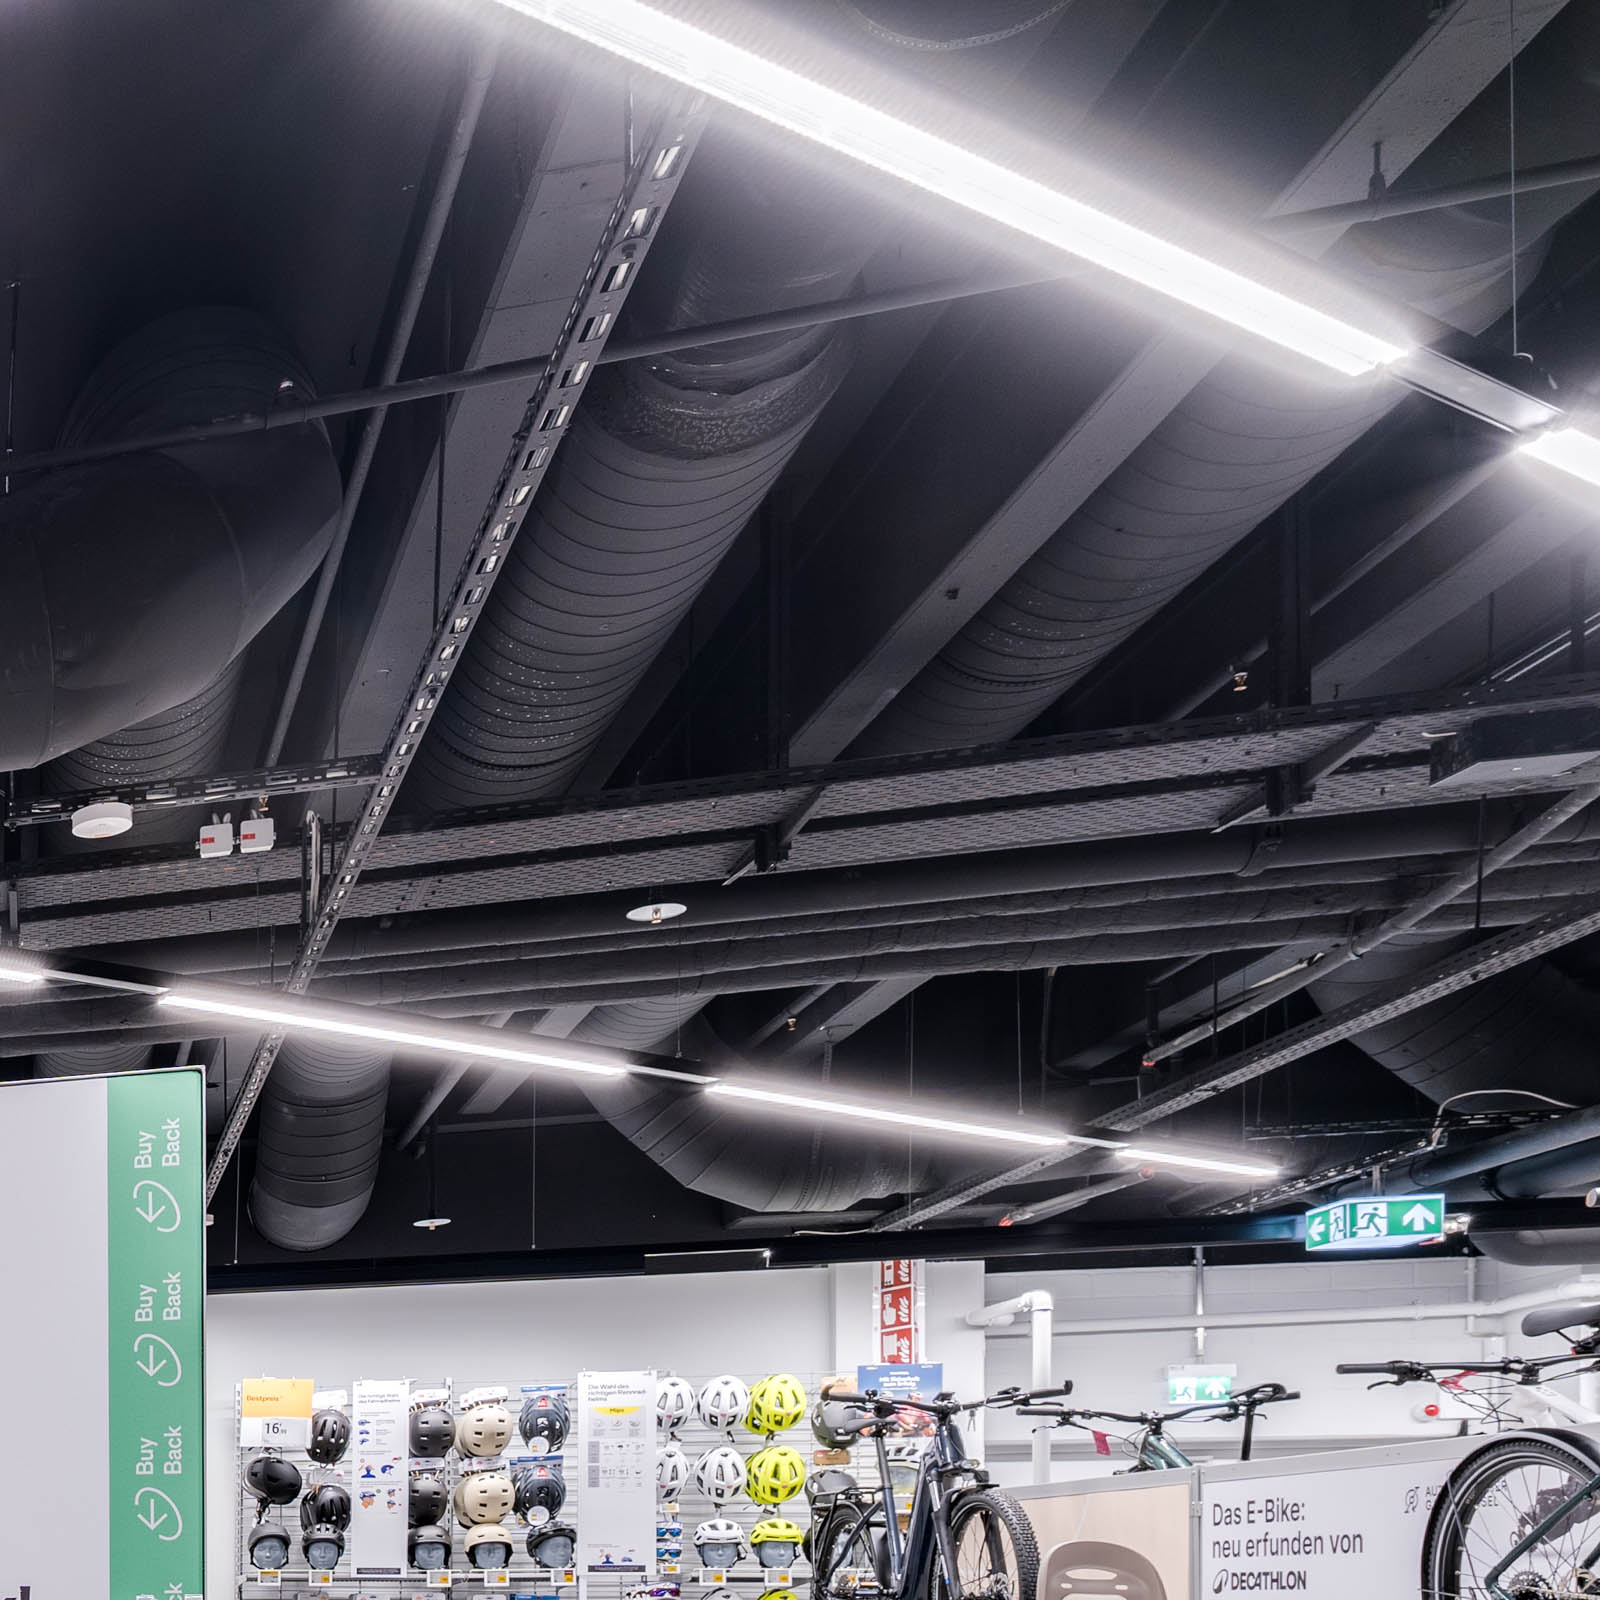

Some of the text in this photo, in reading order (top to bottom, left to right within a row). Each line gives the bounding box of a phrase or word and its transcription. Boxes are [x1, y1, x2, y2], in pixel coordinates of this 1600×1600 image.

[133, 1130, 156, 1169] Buy
[161, 1117, 181, 1167] Back
[134, 1284, 157, 1323] Buy
[162, 1271, 182, 1321] Back
[265, 1423, 280, 1434] 16
[135, 1437, 158, 1476] Buy
[163, 1425, 183, 1476] Back
[1213, 1500, 1305, 1526] Das E-Bike:
[1213, 1531, 1363, 1558] neu erfunden von
[1231, 1570, 1306, 1590] DECATHLON
